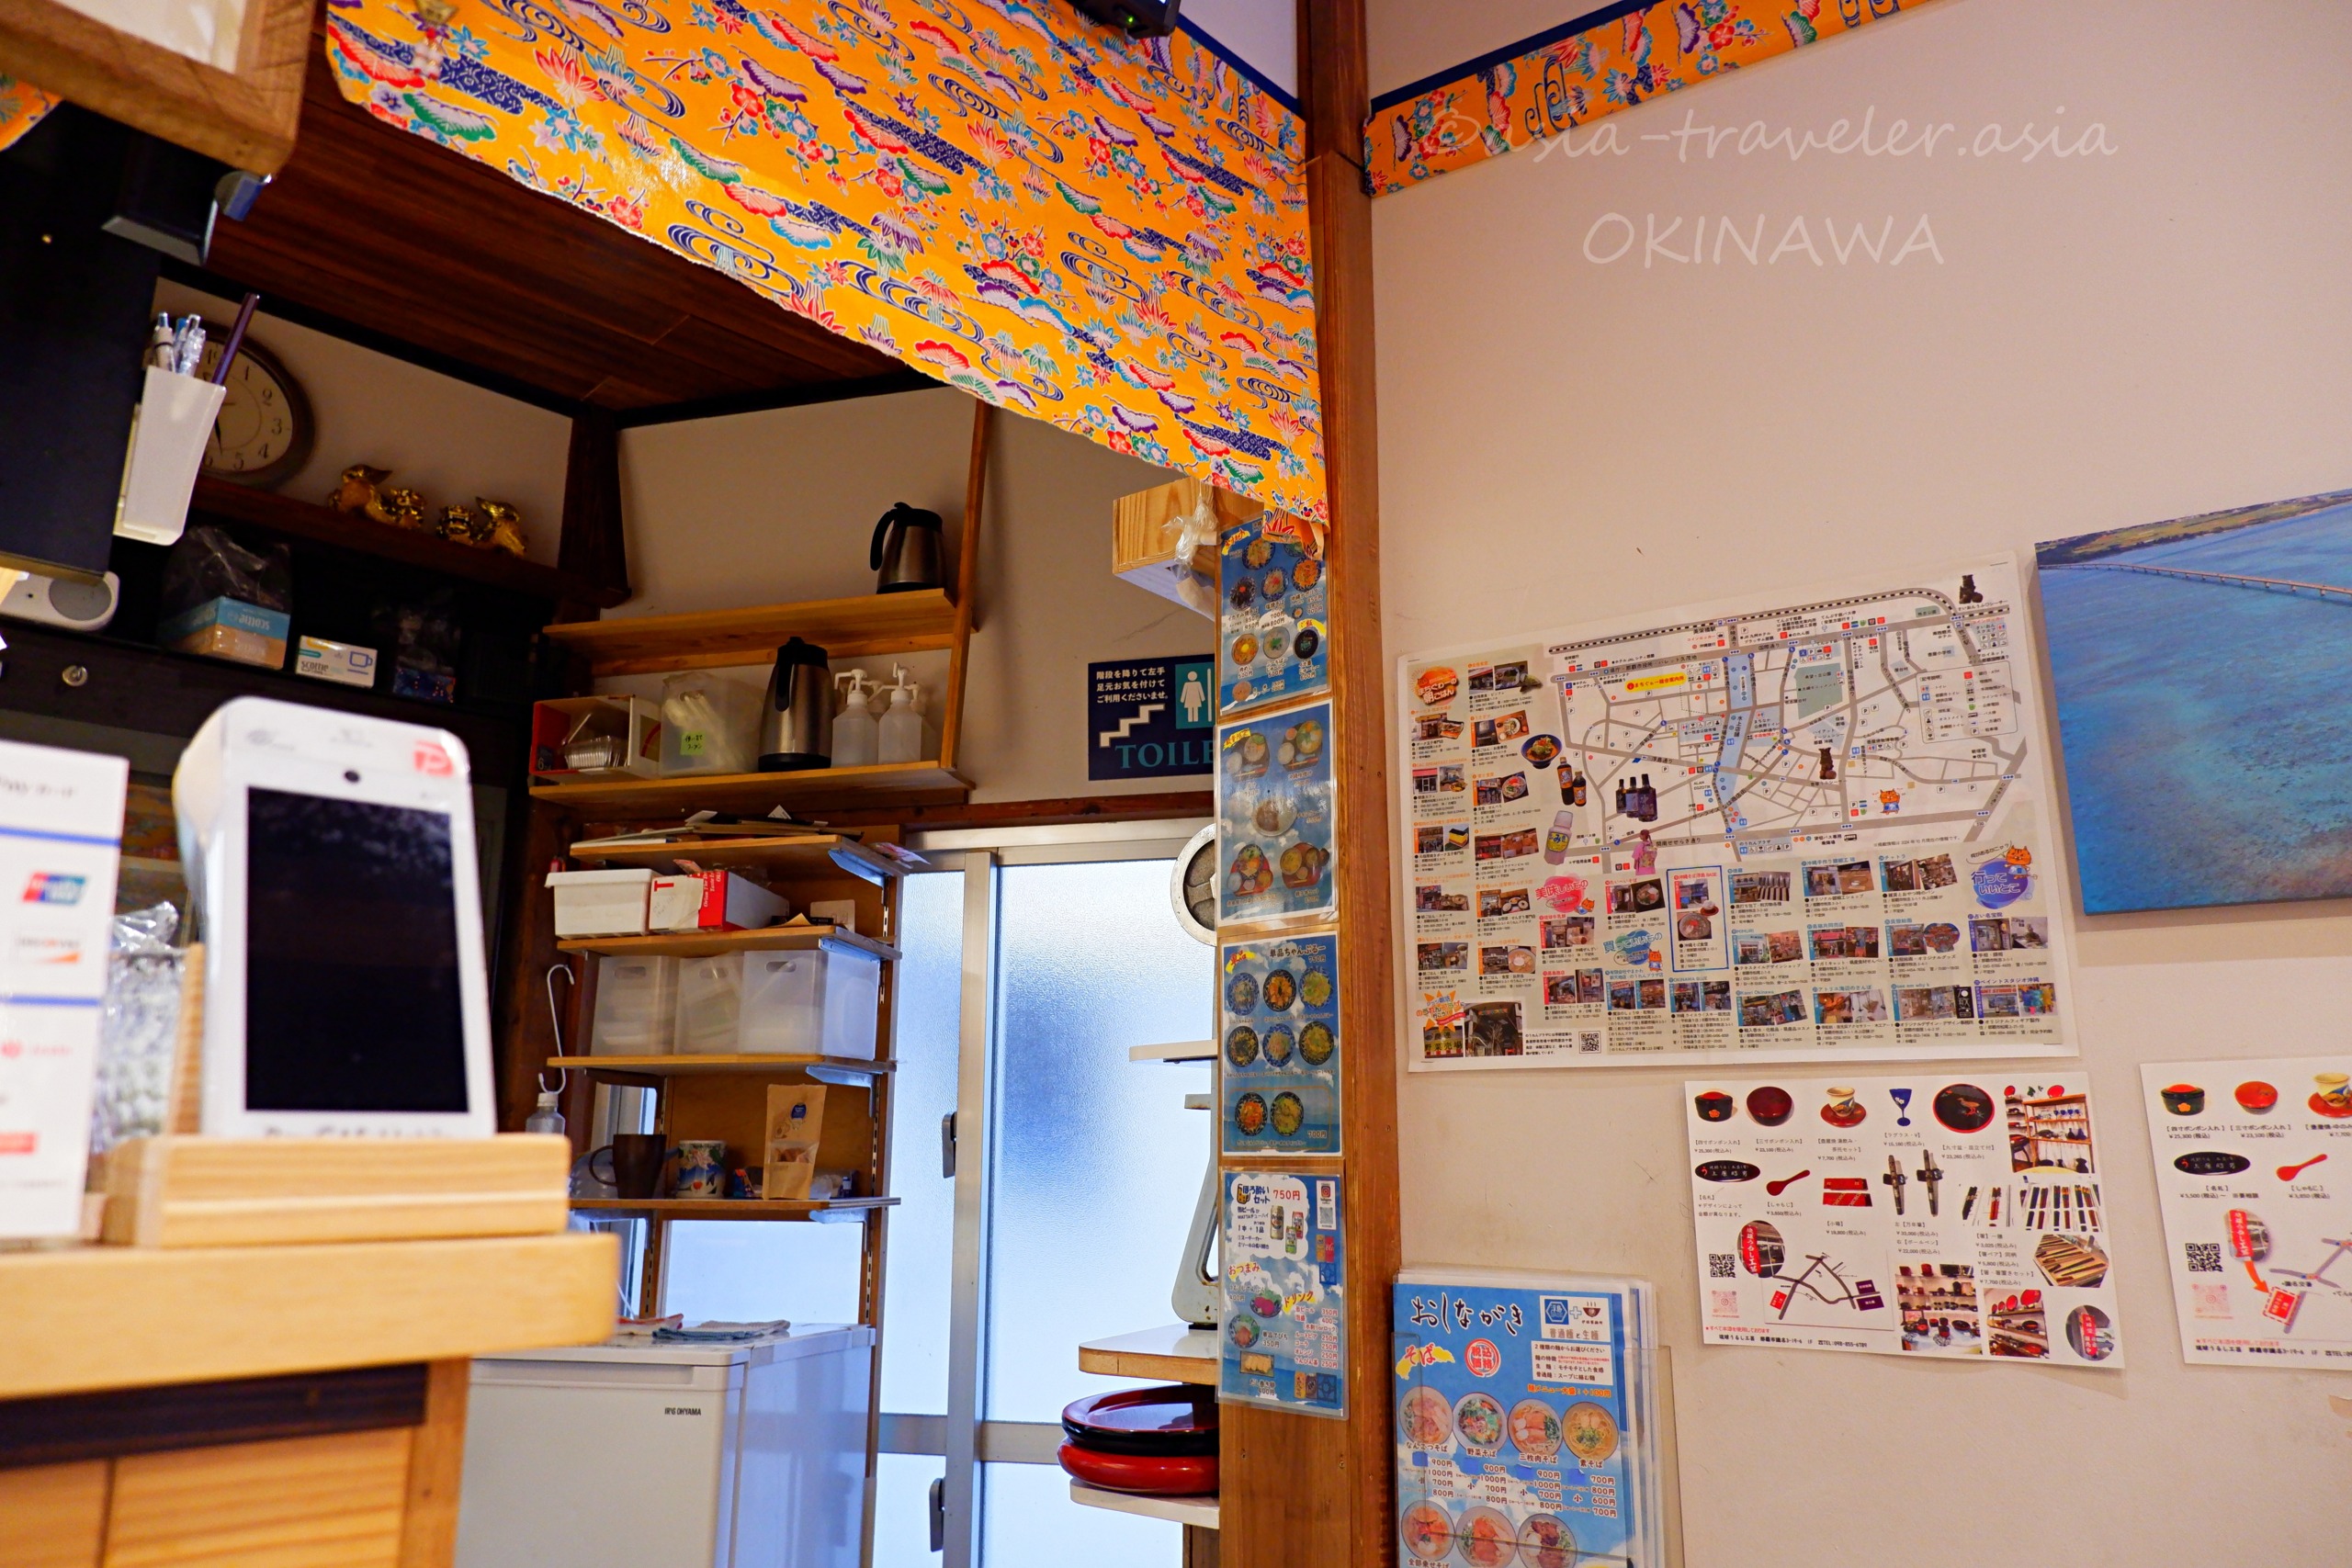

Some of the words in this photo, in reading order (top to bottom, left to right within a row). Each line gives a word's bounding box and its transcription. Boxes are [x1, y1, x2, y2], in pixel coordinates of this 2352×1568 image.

[1096, 667, 1165, 681] 階段を降りて左手
[1096, 679, 1165, 692] 足元お気を付けて
[1097, 691, 1168, 704] ご利用くださいませ。
[1114, 739, 1215, 769] TOILE
[1971, 871, 2007, 885] 行って
[1535, 879, 1589, 900] 美味しいもの
[1978, 884, 2021, 895] いいとこ
[1254, 1195, 1271, 1204] セット
[1273, 1190, 1300, 1201] 750円
[1228, 1262, 1260, 1275] おつまみ
[1284, 1291, 1314, 1308] ドリンク
[1411, 1292, 1524, 1337] おしながき
[1405, 1343, 1436, 1366] そば
[1472, 1347, 1493, 1359] 税込
[1472, 1358, 1492, 1369] 価格
[676, 1407, 701, 1416] OHYAMA
[1466, 1448, 1498, 1458] 野菜そば
[1431, 1459, 1453, 1468] 900円
[1519, 1453, 1557, 1464] 三枚肉そば
[1484, 1464, 1506, 1472] 900円
[1579, 1460, 1603, 1469] 素そば
[1429, 1469, 1453, 1478] 1000円
[1537, 1470, 1560, 1479] 900円
[1432, 1478, 1453, 1487] 700円
[1480, 1475, 1507, 1484] 1000円
[1590, 1475, 1614, 1484] 700円
[1486, 1484, 1507, 1494] 700円
[1534, 1481, 1561, 1490] 1000円
[1433, 1490, 1453, 1498] 800円
[1539, 1491, 1562, 1500] 700円
[1591, 1487, 1615, 1495] 800円
[1486, 1495, 1508, 1505] 800円
[1592, 1497, 1616, 1506] 600円
[1540, 1502, 1562, 1510] 800円
[1593, 1508, 1617, 1517] 700円
